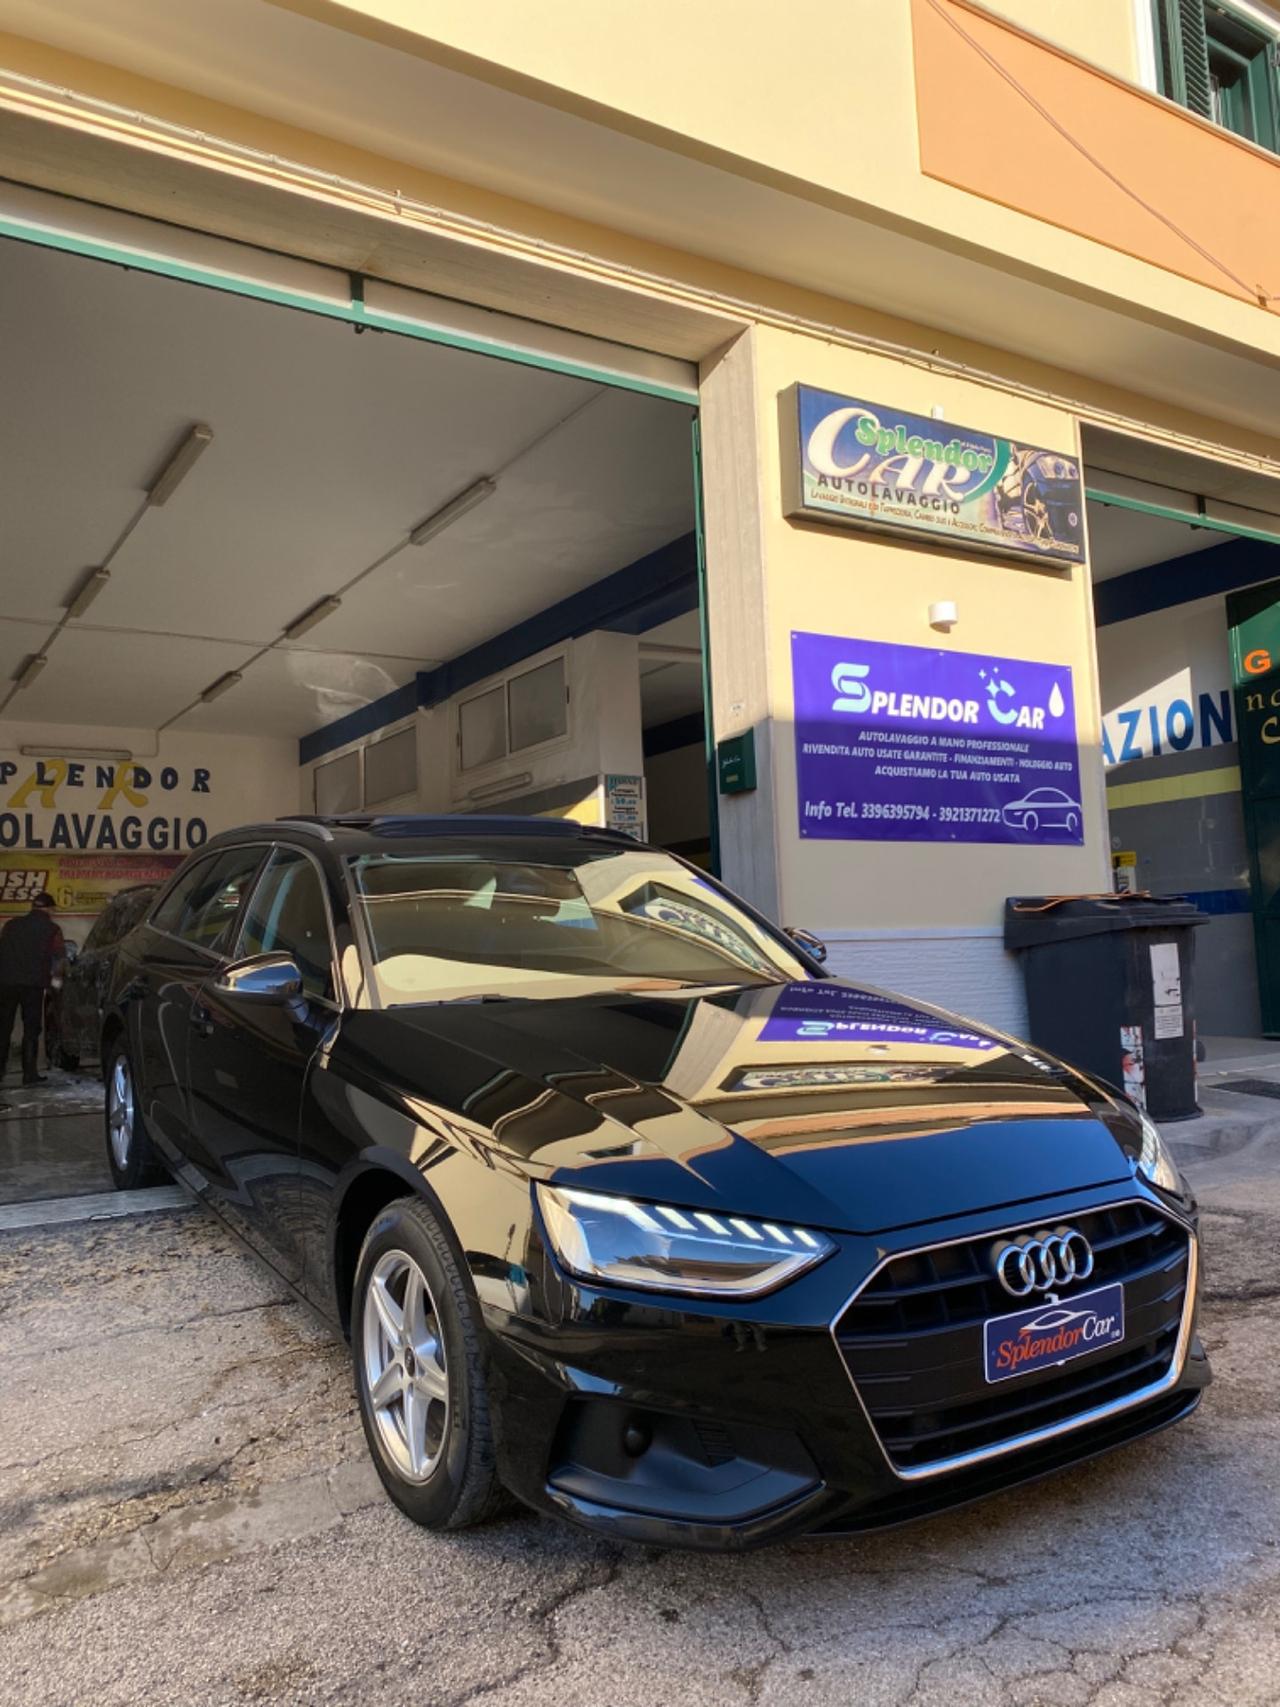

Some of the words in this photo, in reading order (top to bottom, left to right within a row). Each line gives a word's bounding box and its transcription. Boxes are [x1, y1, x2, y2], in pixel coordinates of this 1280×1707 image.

[808, 407, 970, 500] CAR
[855, 415, 993, 474] Splendor
[816, 473, 961, 514] AUTOLAVAGGIO
[831, 662, 979, 724] SPLENDOR
[986, 679, 1046, 730] CAR
[802, 743, 850, 756] RIVENDITA
[851, 747, 875, 758] AUTO
[876, 749, 902, 760] USATE
[903, 750, 948, 763] GARANTITE
[954, 753, 1015, 767] FINANZIAMENTI
[858, 731, 928, 746] AUTOLAVAGGIO
[930, 736, 938, 746] A
[939, 738, 966, 748] MANO
[967, 740, 1030, 753] PROFESSIONALE
[0, 761, 211, 793] PLENDOR
[875, 765, 937, 778] ACQUISTIAMO
[938, 769, 949, 779] LA
[950, 770, 968, 780] TUA
[969, 771, 991, 782] AUTO
[993, 772, 1021, 783] USATA
[805, 800, 832, 820] Info
[836, 801, 858, 818] Tel.
[0, 813, 208, 850] OLAVAGGIO
[996, 1314, 1115, 1370] SplendorCar
